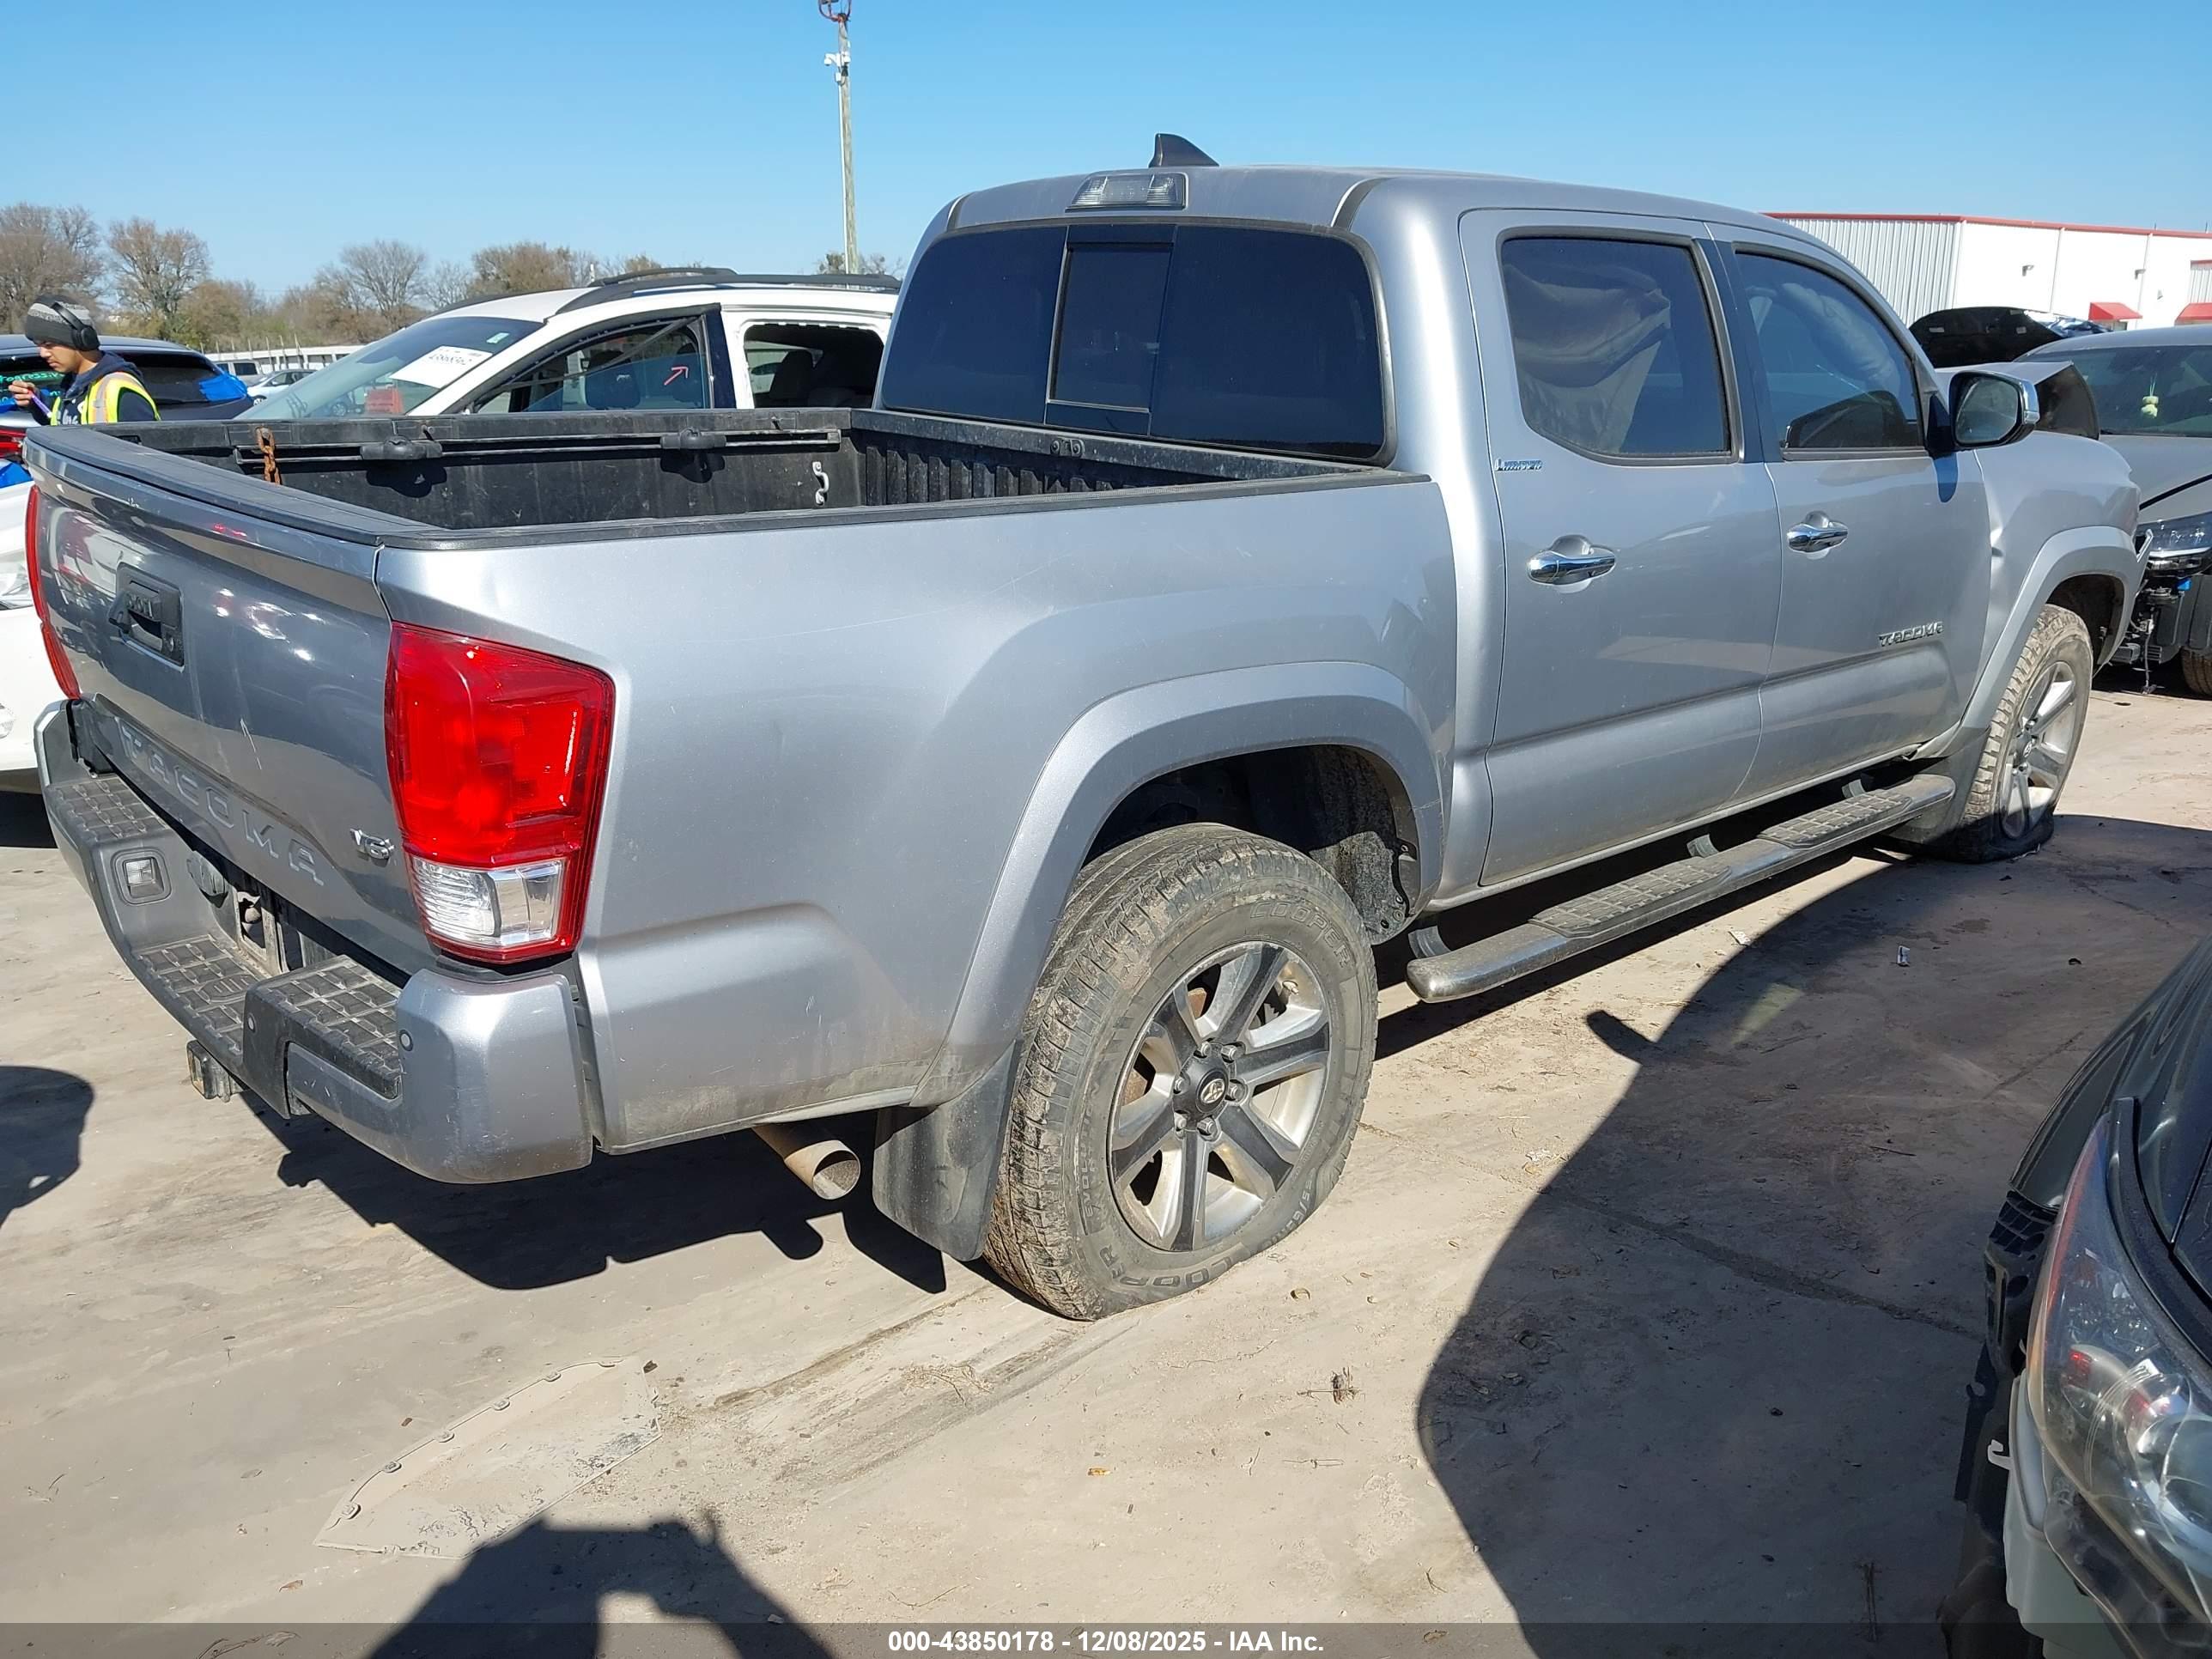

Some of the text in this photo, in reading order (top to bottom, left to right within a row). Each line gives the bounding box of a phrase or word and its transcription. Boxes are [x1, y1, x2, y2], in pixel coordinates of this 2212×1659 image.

[1877, 620, 1943, 647] TACOMA
[119, 724, 324, 886] TACOMA
[349, 827, 395, 860] V6
[1249, 901, 1352, 969] COOPER
